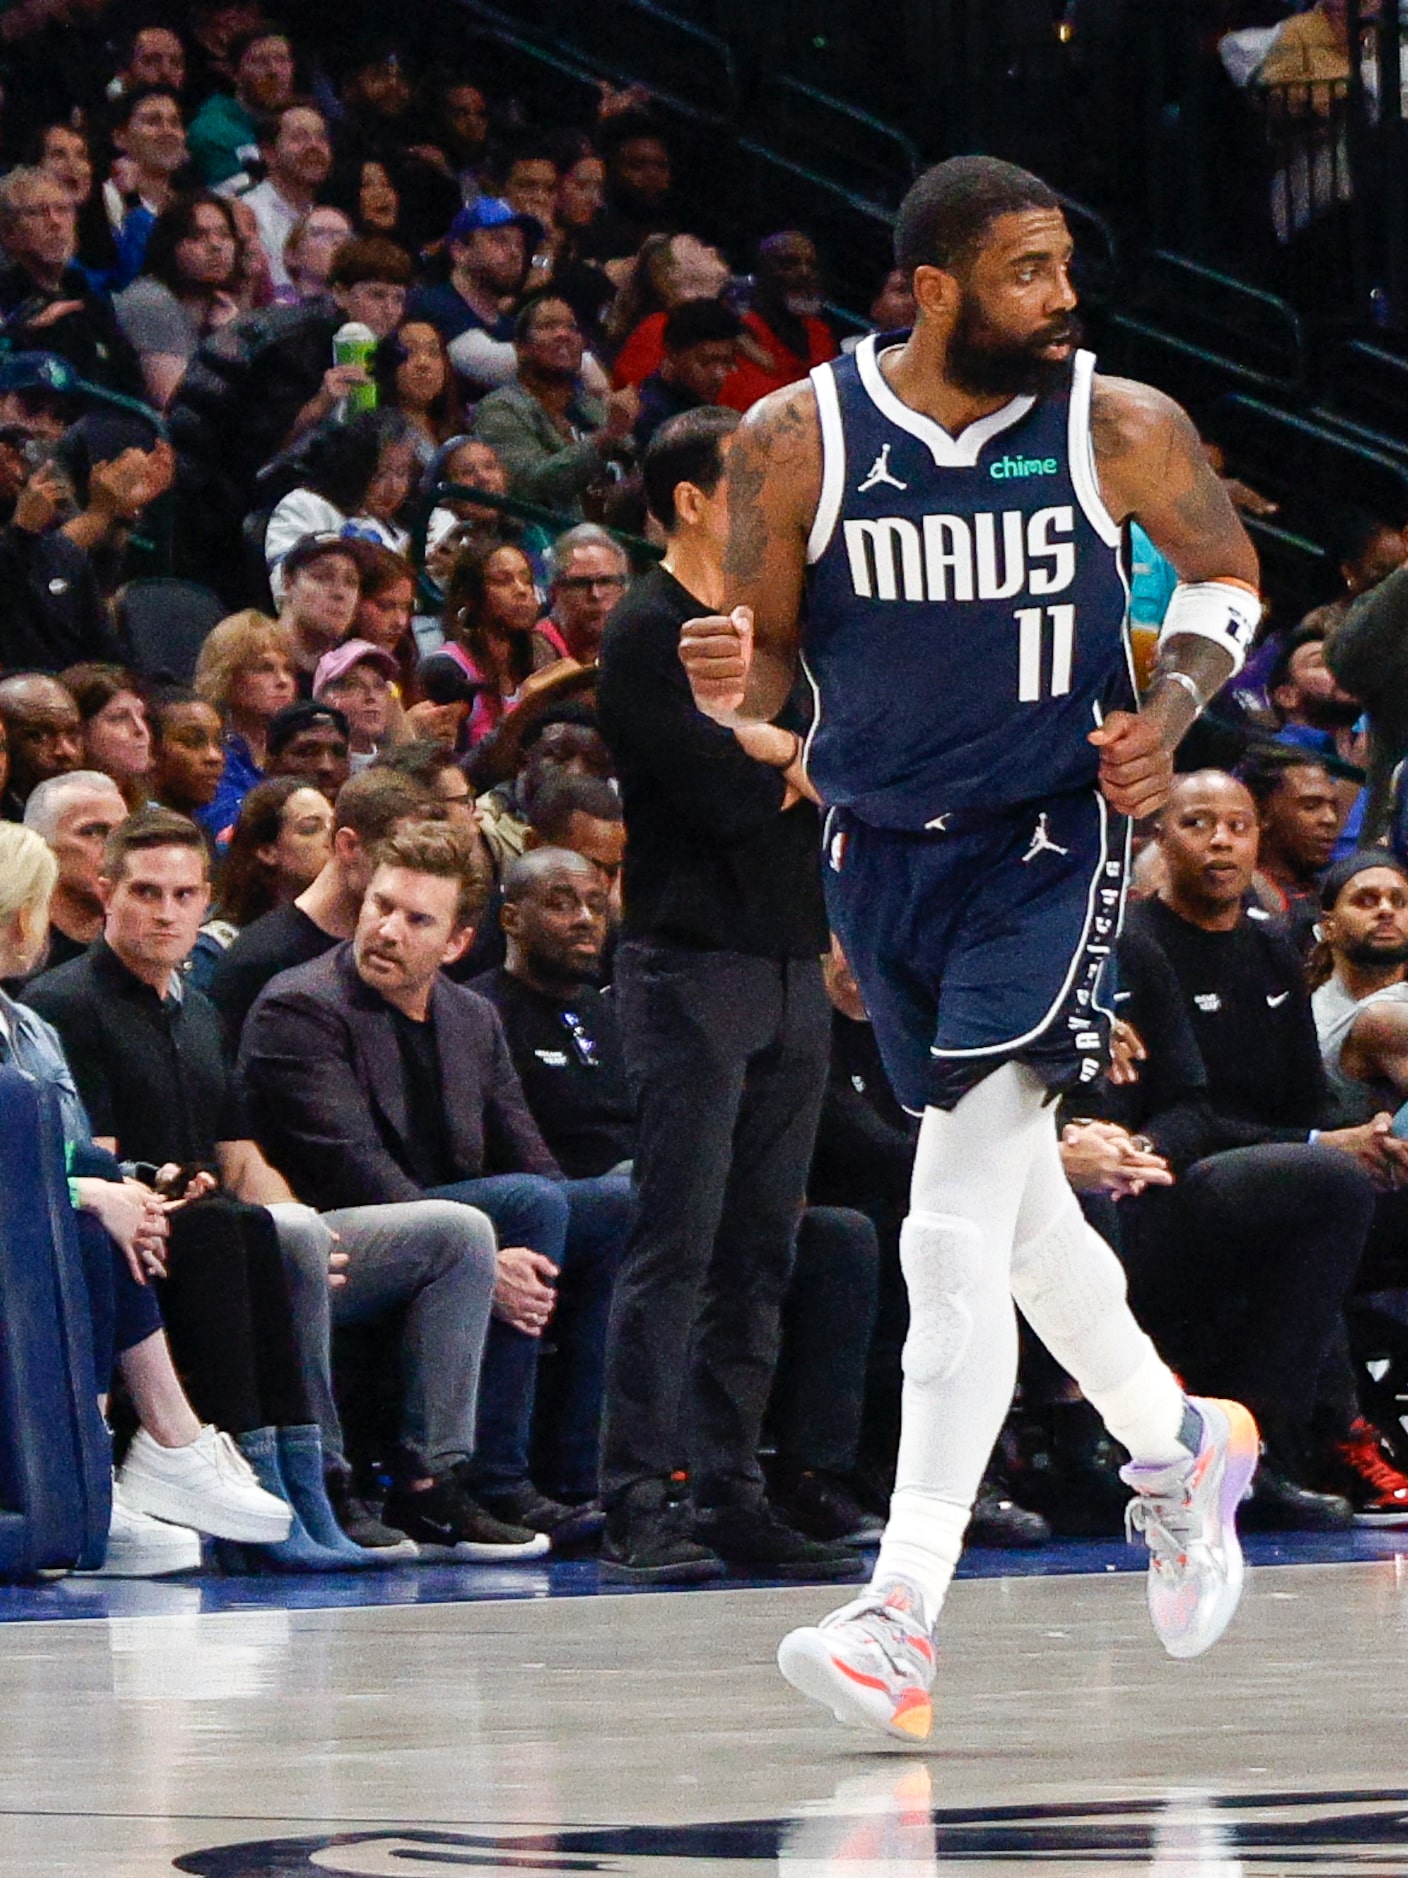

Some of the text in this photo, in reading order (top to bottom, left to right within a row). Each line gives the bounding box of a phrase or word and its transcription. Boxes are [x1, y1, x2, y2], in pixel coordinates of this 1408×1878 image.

[990, 455, 1057, 479] chime
[843, 505, 1076, 601] MAVS
[1013, 604, 1075, 703] 11
